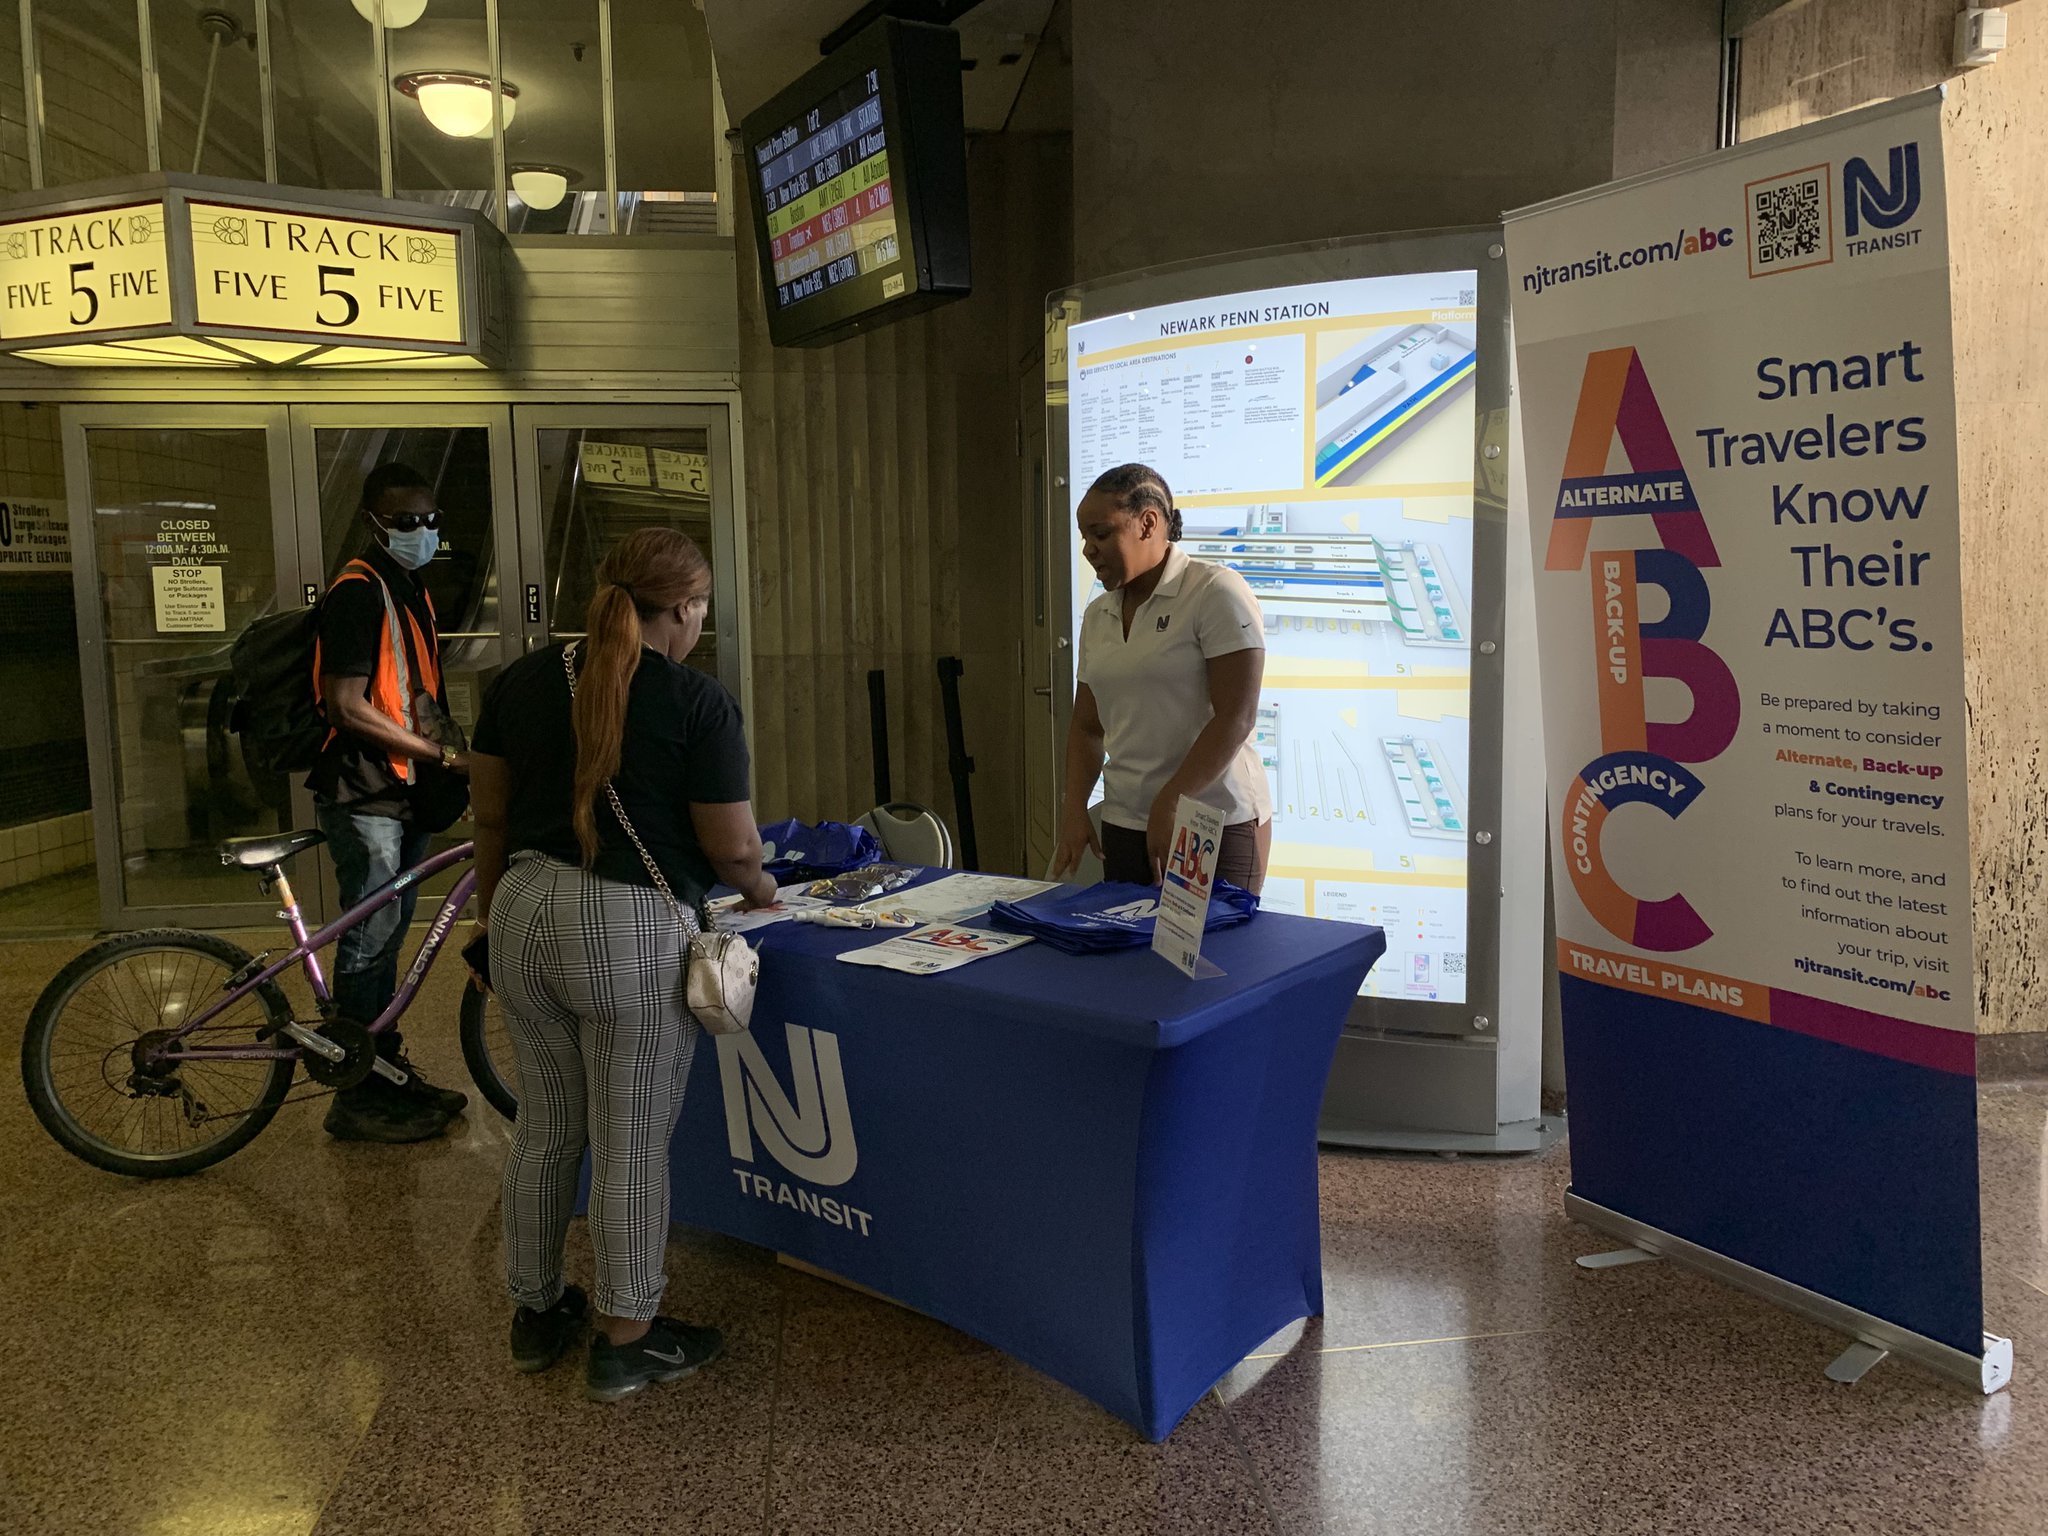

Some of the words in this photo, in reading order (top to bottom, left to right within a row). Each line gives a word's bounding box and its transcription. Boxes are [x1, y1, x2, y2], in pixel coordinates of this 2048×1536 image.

[781, 122, 798, 149] Station
[814, 107, 820, 128] 2
[809, 137, 821, 160] LINE
[819, 124, 840, 154] (TRAIN)
[841, 116, 853, 140] TRK
[858, 100, 879, 130] STATUS
[858, 137, 867, 158] All
[865, 126, 885, 154] Aboard
[789, 200, 805, 224] Boston
[851, 171, 857, 191] 2
[862, 164, 870, 183] All
[1843, 142, 1921, 237] NJ
[854, 199, 860, 217] 4
[29, 217, 125, 258] TRACK
[255, 219, 400, 262] TRACK
[1846, 229, 1922, 257] TRANSIT
[827, 263, 838, 284] NEC
[1523, 225, 1734, 294] njtransit.com/abc
[7, 280, 53, 310] FIVE
[69, 260, 99, 326] 5
[109, 268, 159, 299] FIVE
[213, 270, 288, 301] FIVE
[316, 264, 361, 327] 5
[378, 285, 444, 313] FIVE
[1160, 315, 1216, 336] NEWARK
[1221, 309, 1259, 327] PENN
[1265, 301, 1329, 321] STATION
[1115, 360, 1129, 369] LOCAL
[1142, 353, 1176, 364] DESTINATIONS
[1757, 340, 1924, 401] Smart
[1696, 413, 1927, 468] Travelers
[12, 503, 50, 517] Strollers
[1560, 480, 1684, 508] ALTERNATE
[1772, 483, 1930, 525] Know
[13, 518, 36, 532] Large
[15, 534, 24, 544] or
[28, 532, 67, 546] Packages
[157, 532, 216, 542] BETWEEN
[160, 520, 210, 530] CLOSED
[172, 556, 203, 566] DAILY
[173, 569, 202, 578] STOP
[1791, 539, 1931, 587] Their
[529, 587, 537, 621] PULL
[1603, 560, 1627, 684] BACK-UP
[1764, 606, 1933, 652] ABC's.
[1396, 663, 1405, 674] 5
[1760, 693, 1780, 707] Be
[1784, 696, 1852, 712] prepared
[1858, 699, 1877, 716] by
[1883, 701, 1941, 720] taking
[1762, 722, 1771, 733] a
[1775, 722, 1840, 740] moment
[1845, 728, 1861, 742] to
[1866, 730, 1942, 748] consider
[1775, 749, 1858, 772] Alternate,
[1862, 758, 1943, 780] Back-up
[1809, 780, 1821, 793] &
[1825, 782, 1944, 809] Contingency
[1287, 804, 1294, 814] 1
[1309, 806, 1319, 817] 2
[1334, 808, 1343, 818] 3
[1356, 810, 1367, 820] 4
[1573, 765, 1686, 875] CONTINGENCY
[1774, 803, 1813, 820] plans
[1817, 807, 1837, 823] for
[1841, 813, 1877, 830] your
[1882, 816, 1945, 837] travels.
[1168, 826, 1215, 886] ABC
[1399, 856, 1411, 868] 5
[1795, 851, 1812, 866] To
[1816, 854, 1853, 873] learn
[1858, 864, 1906, 884] more,
[1911, 869, 1946, 887] and
[1781, 876, 1796, 890] to
[1801, 878, 1831, 896] find
[1835, 887, 1861, 902] out
[1866, 890, 1893, 908] the
[1898, 895, 1948, 916] latest
[910, 929, 1009, 951] ABC
[1801, 905, 1890, 935] information
[1896, 923, 1949, 944] about
[1837, 940, 1872, 958] your
[1877, 948, 1908, 968] trip,
[1913, 954, 1950, 973] visit
[1570, 949, 1655, 987] TRAVEL
[1662, 971, 1744, 1007] PLANS
[1794, 956, 1951, 1002] njtransit.com/abc
[733, 1168, 873, 1237] TRANSIT
